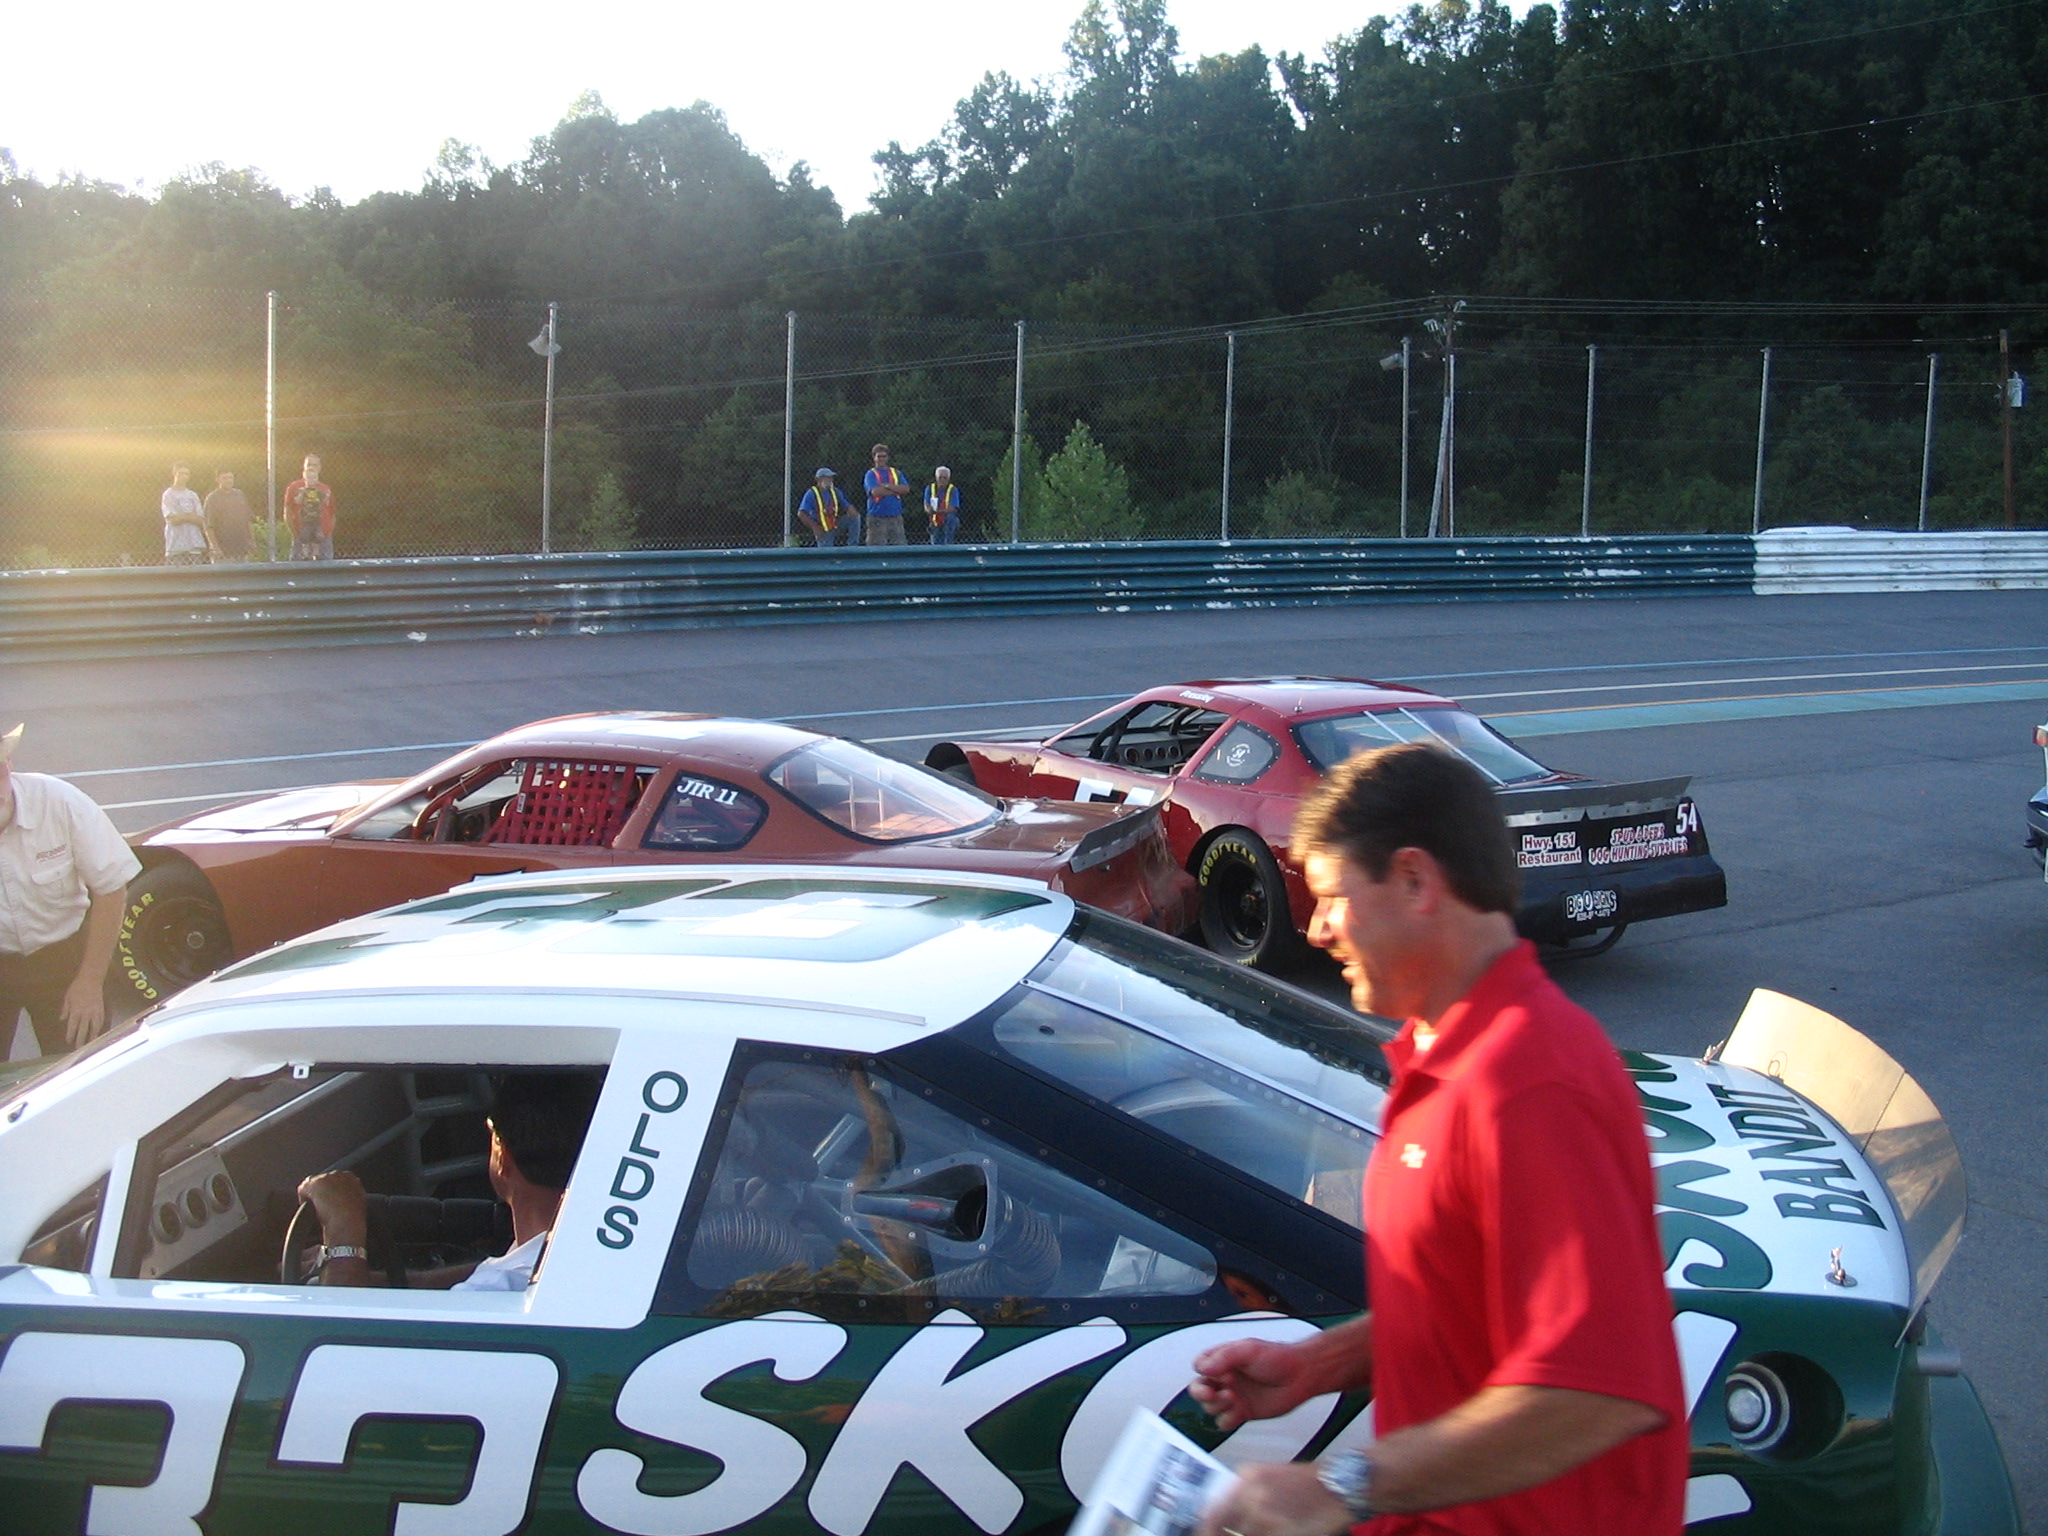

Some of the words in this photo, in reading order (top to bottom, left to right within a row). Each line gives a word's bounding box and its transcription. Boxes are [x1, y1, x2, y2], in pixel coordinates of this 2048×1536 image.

[676, 780, 714, 799] JIR
[714, 788, 739, 806] 11
[1675, 802, 1698, 834] 54
[1517, 846, 1582, 868] Restaurant
[1522, 834, 1553, 852] Hwy.
[1553, 832, 1576, 849] 151
[1588, 846, 1611, 866] DOG
[1200, 842, 1257, 886] GOODYEAR
[119, 892, 157, 999] GOODYEAR
[597, 1071, 688, 1249] OLDS
[1706, 1083, 1887, 1231] BANDIT
